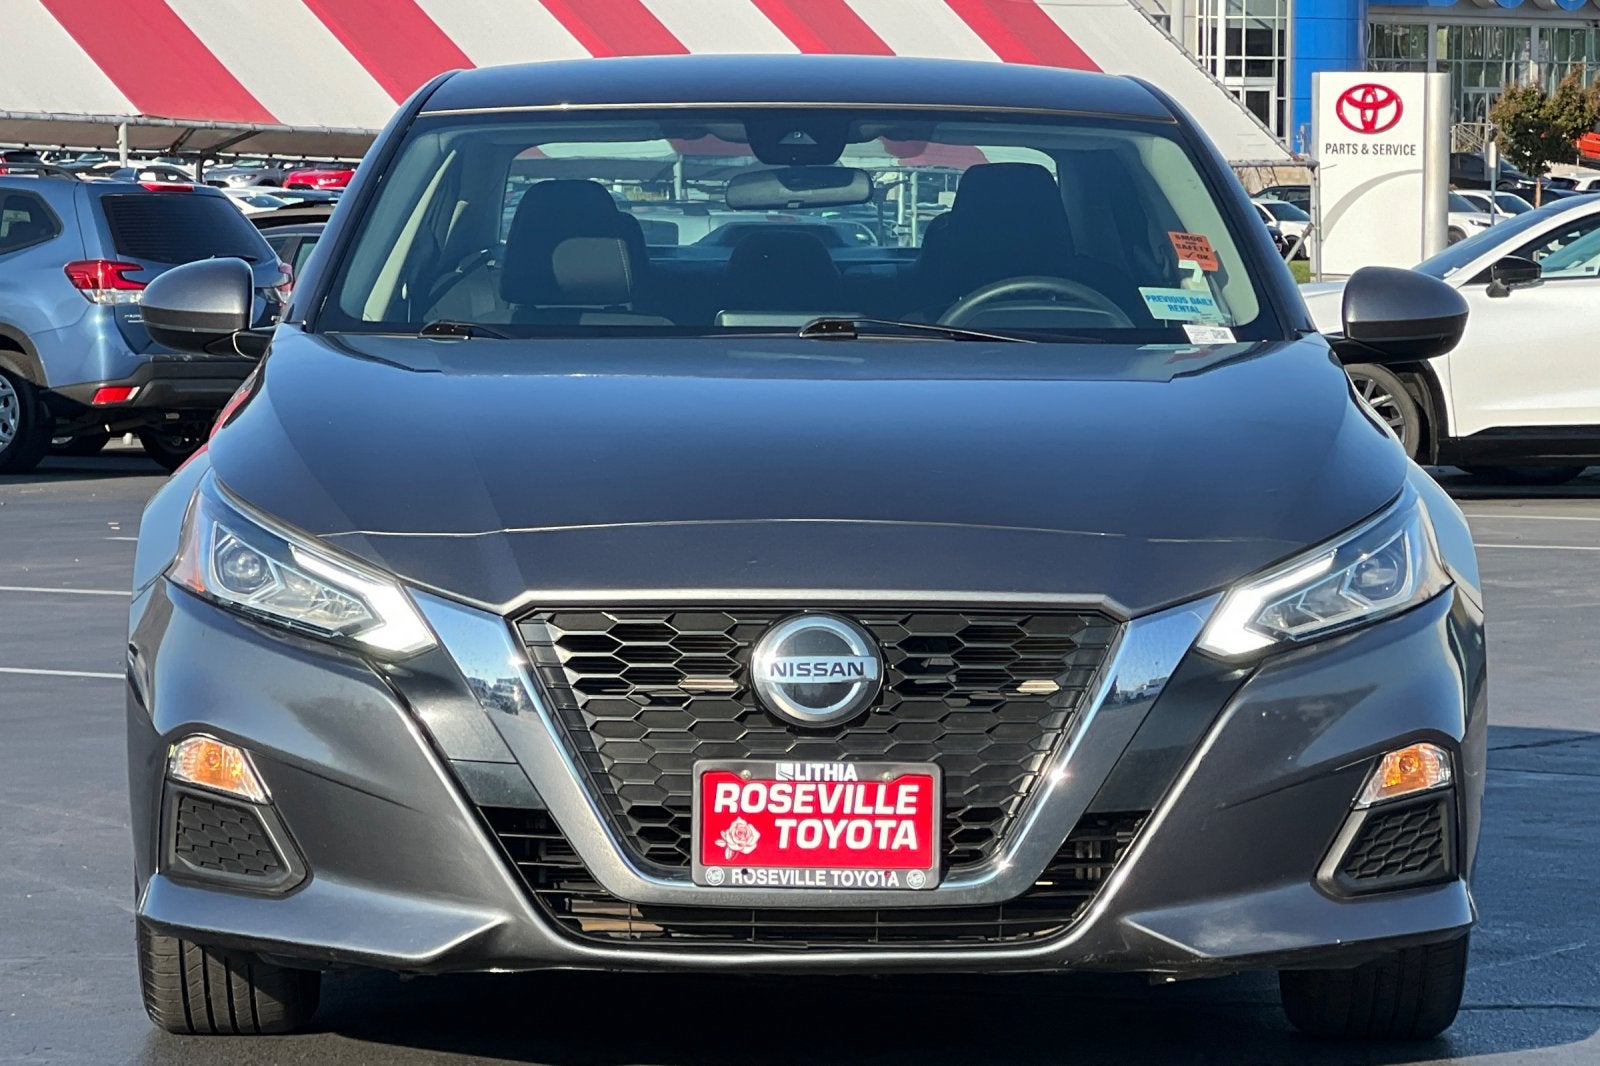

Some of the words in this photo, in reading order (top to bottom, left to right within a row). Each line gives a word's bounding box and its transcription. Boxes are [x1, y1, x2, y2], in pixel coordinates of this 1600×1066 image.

[1325, 143, 1358, 155] PARTS
[1361, 143, 1369, 155] &
[1372, 144, 1416, 156] SERVICE
[1175, 243, 1210, 252] SAFETY
[1145, 294, 1188, 304] PREVIOUS
[1189, 297, 1214, 306] DAILY
[1168, 305, 1201, 313] RENTAL
[770, 662, 864, 677] NISSAN
[794, 763, 858, 781] LITHIA
[714, 783, 919, 815] ROSEVILLE
[774, 819, 918, 850] TOYOTA
[731, 869, 826, 887] ROSEVILLE
[830, 870, 900, 887] TOYOTA
